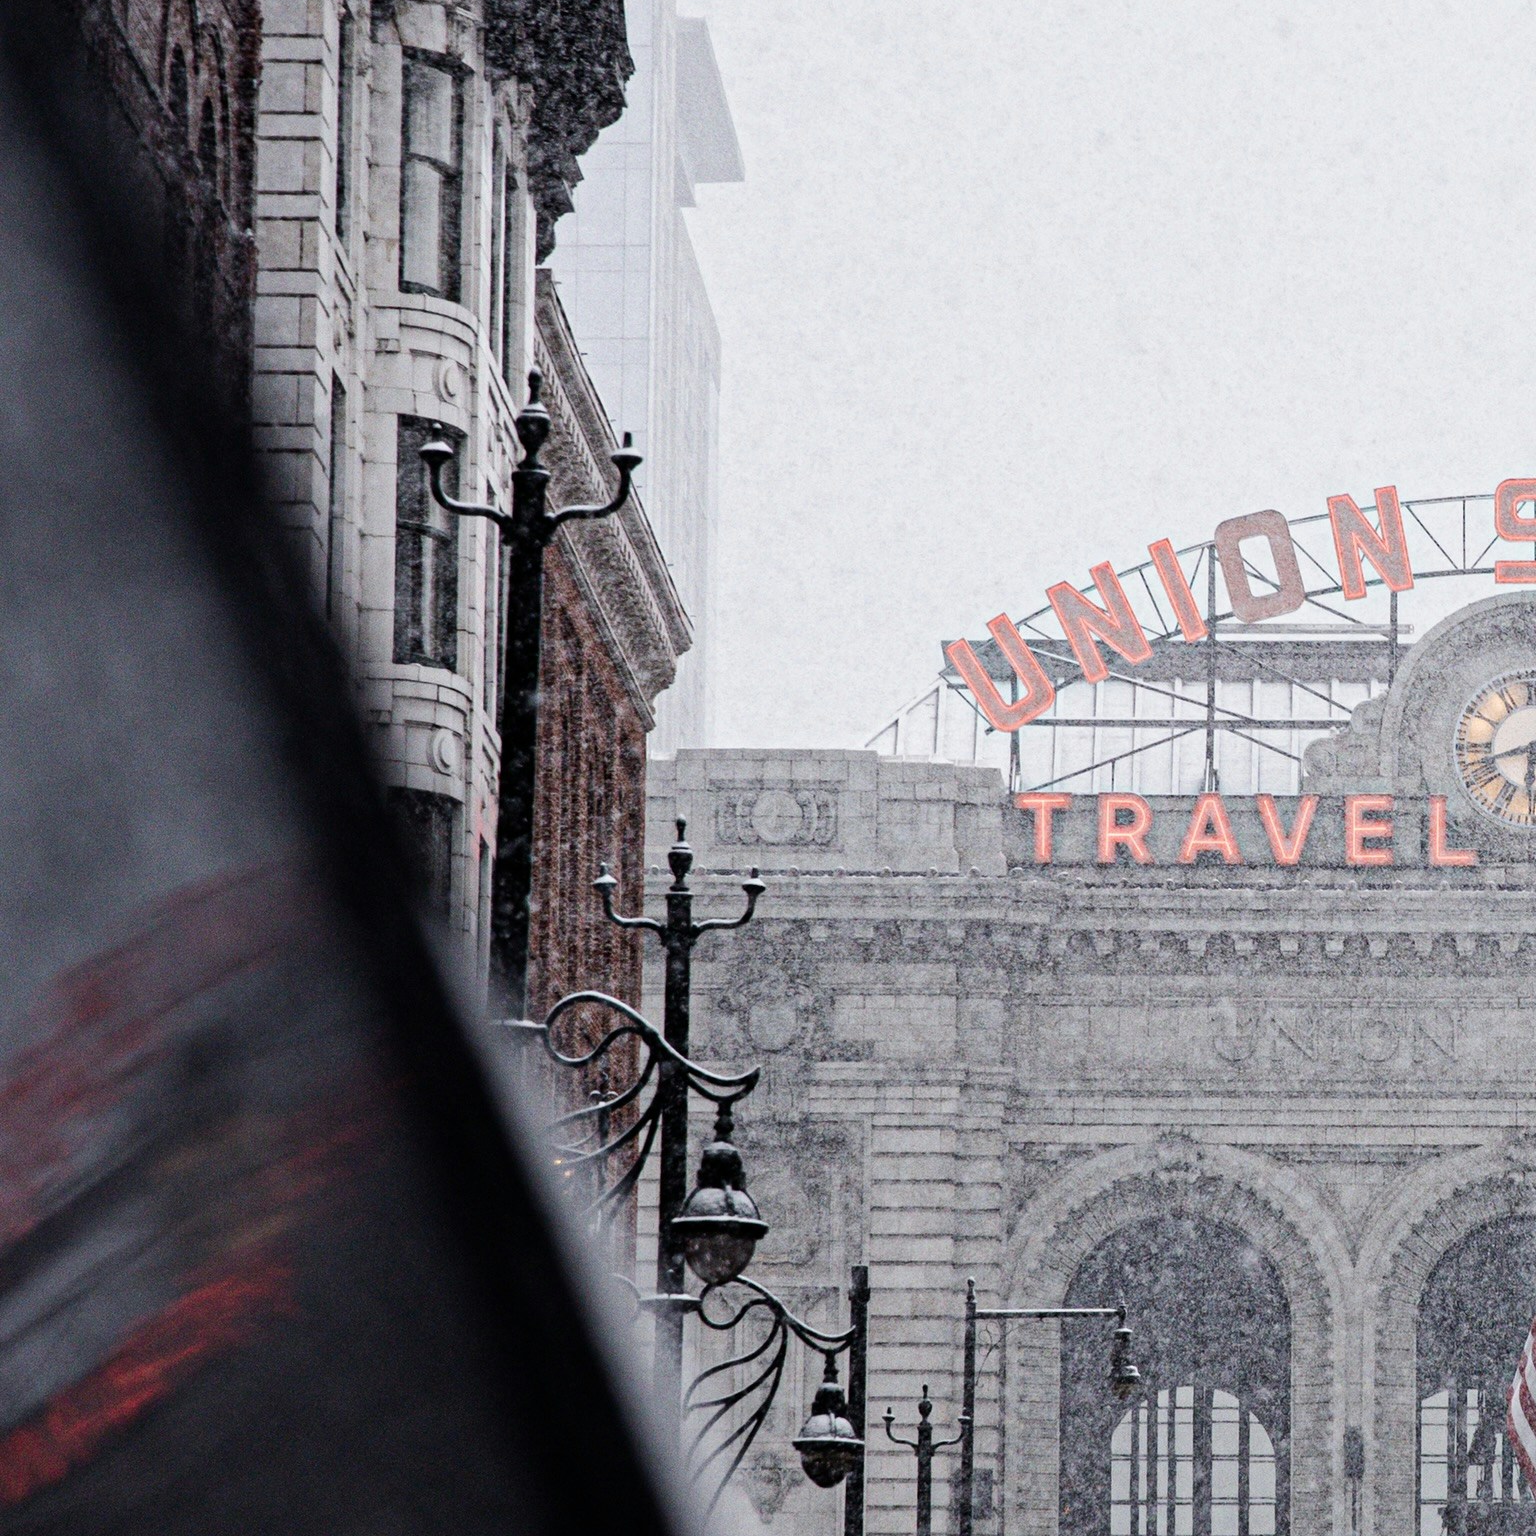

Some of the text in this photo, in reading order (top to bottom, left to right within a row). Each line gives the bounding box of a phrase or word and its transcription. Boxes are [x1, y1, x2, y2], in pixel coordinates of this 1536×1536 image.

[947, 485, 1414, 733] UNION
[1014, 791, 1478, 867] TRAVEL
[1211, 1015, 1459, 1066] UNION
